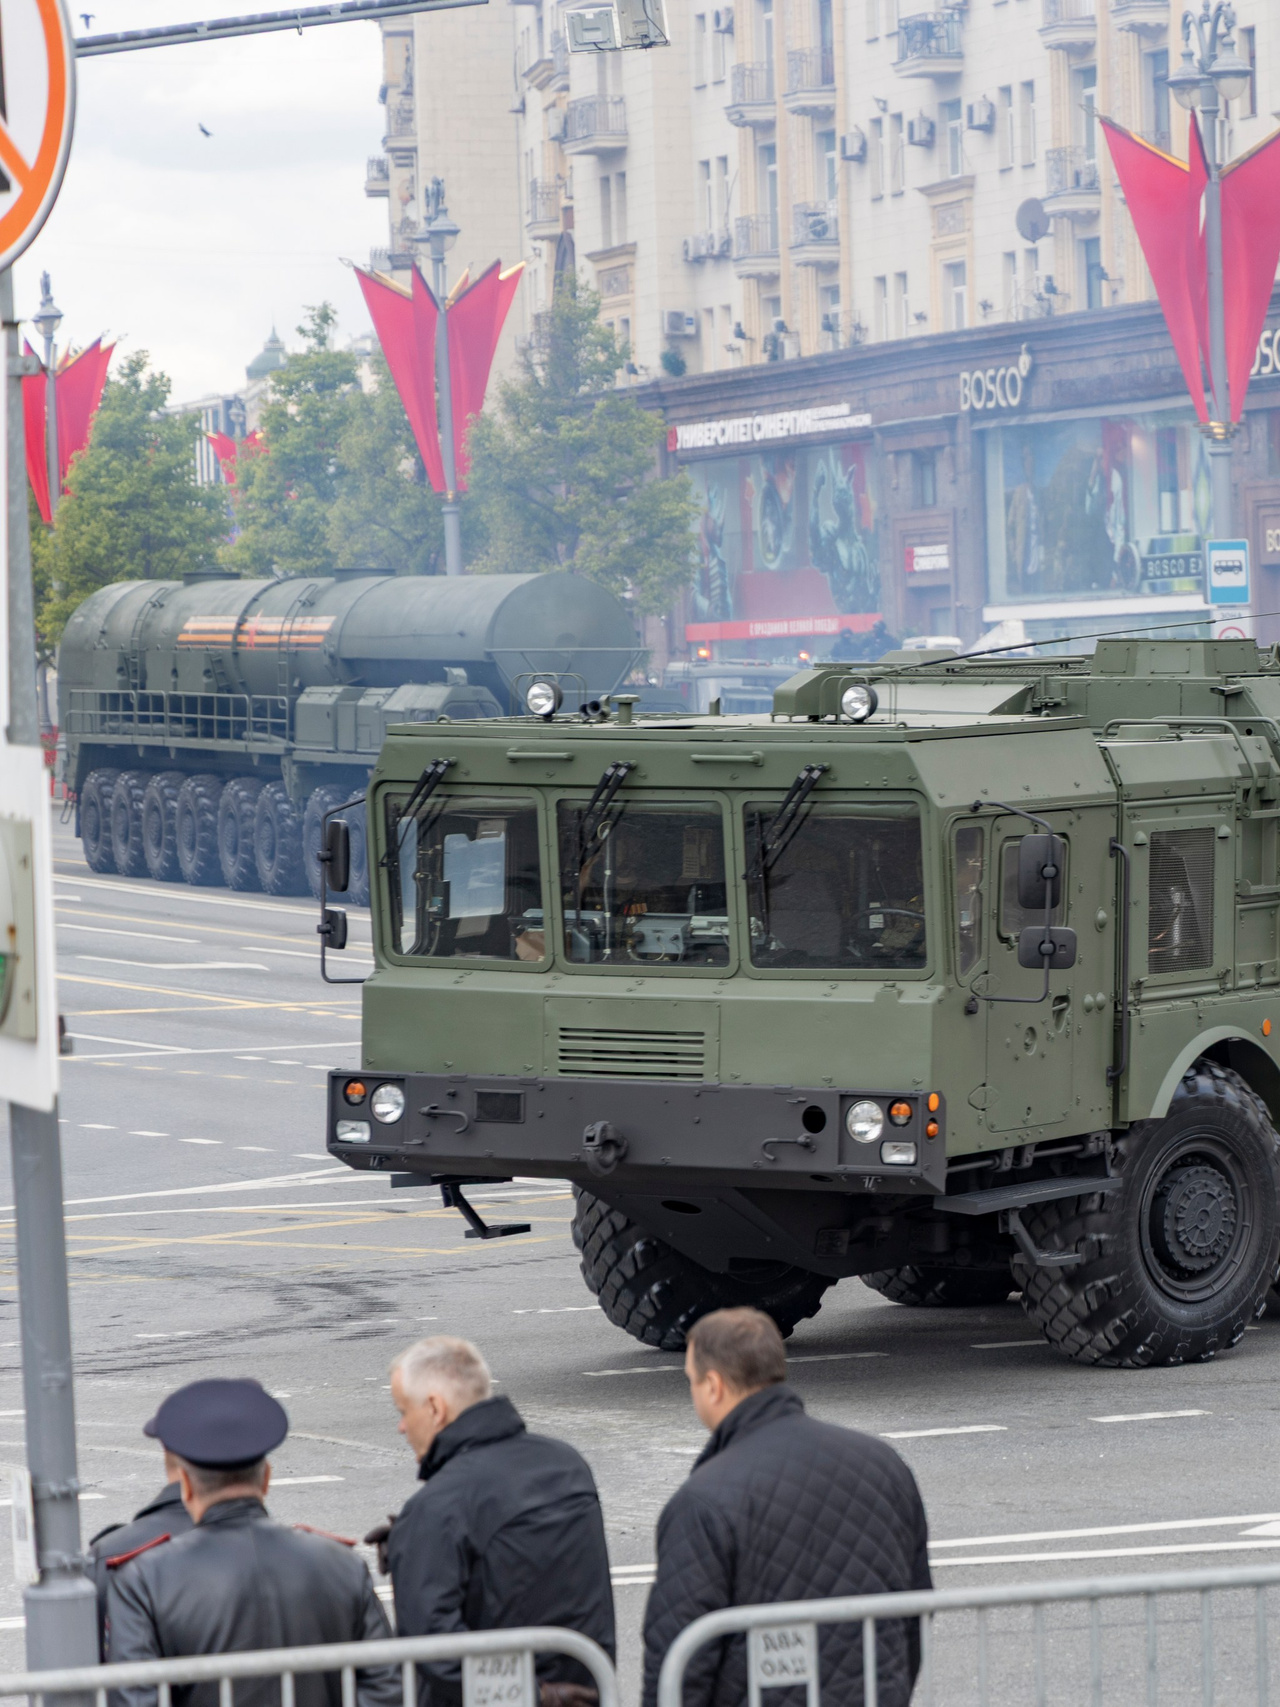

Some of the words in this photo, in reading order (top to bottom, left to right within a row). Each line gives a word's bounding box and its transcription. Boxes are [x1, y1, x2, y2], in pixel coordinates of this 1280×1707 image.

[960, 366, 1022, 411] BOSCO
[677, 416, 753, 449] УНИВЕРСИТЕТ
[1147, 558, 1185, 577] BOSCO
